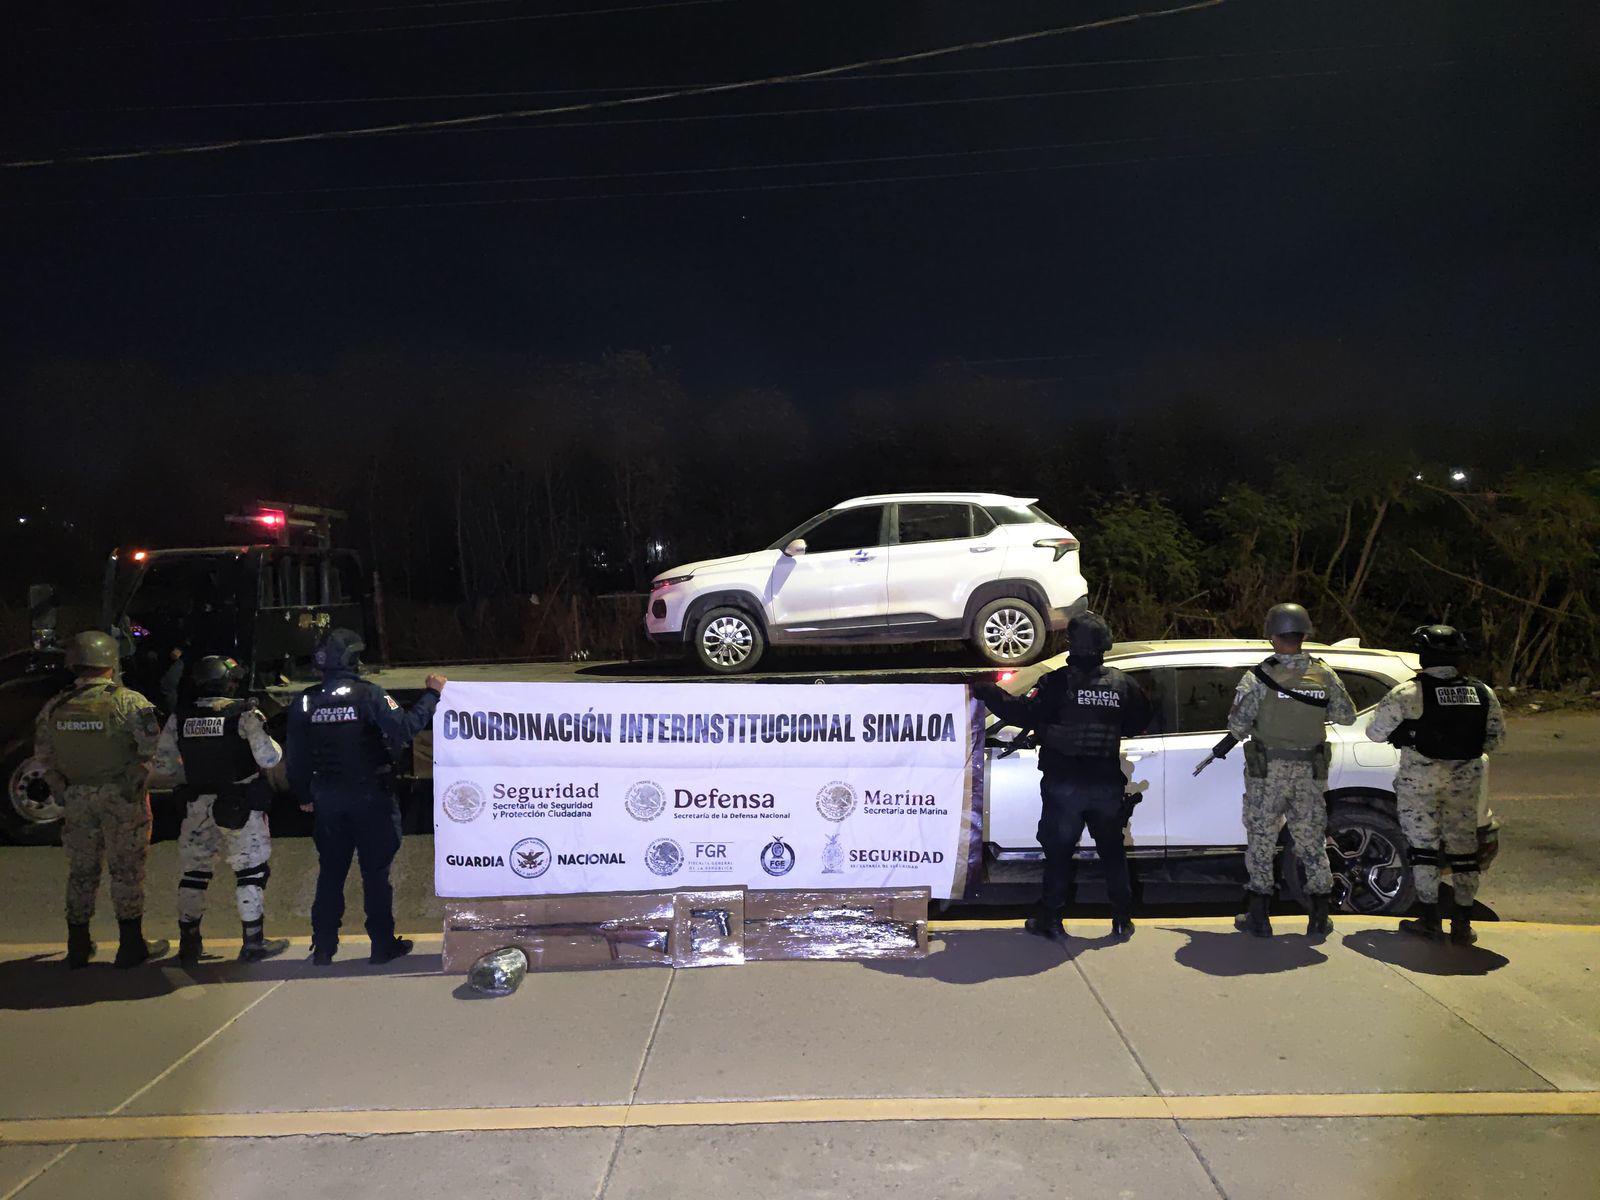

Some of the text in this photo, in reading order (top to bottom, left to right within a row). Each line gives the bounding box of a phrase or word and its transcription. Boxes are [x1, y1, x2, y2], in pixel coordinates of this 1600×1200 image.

[1077, 697, 1120, 708] ESTATAL
[311, 713, 358, 723] ESTATAL
[443, 707, 957, 744] COORDINACIÓN INTERINSTITUCIONAL SINALOA
[492, 782, 600, 804] Seguridad
[674, 788, 775, 809] Defensa
[863, 789, 936, 806] Marina
[537, 802, 549, 810] de
[550, 801, 593, 811] Seguridad
[906, 807, 918, 815] de
[919, 807, 948, 816] Marina
[492, 810, 592, 820] y Protección Ciudadana
[695, 843, 727, 858] FGR
[849, 849, 944, 864] SEGURIDAD
[446, 854, 505, 868] GUARDIA
[557, 852, 626, 866] NACIONAL
